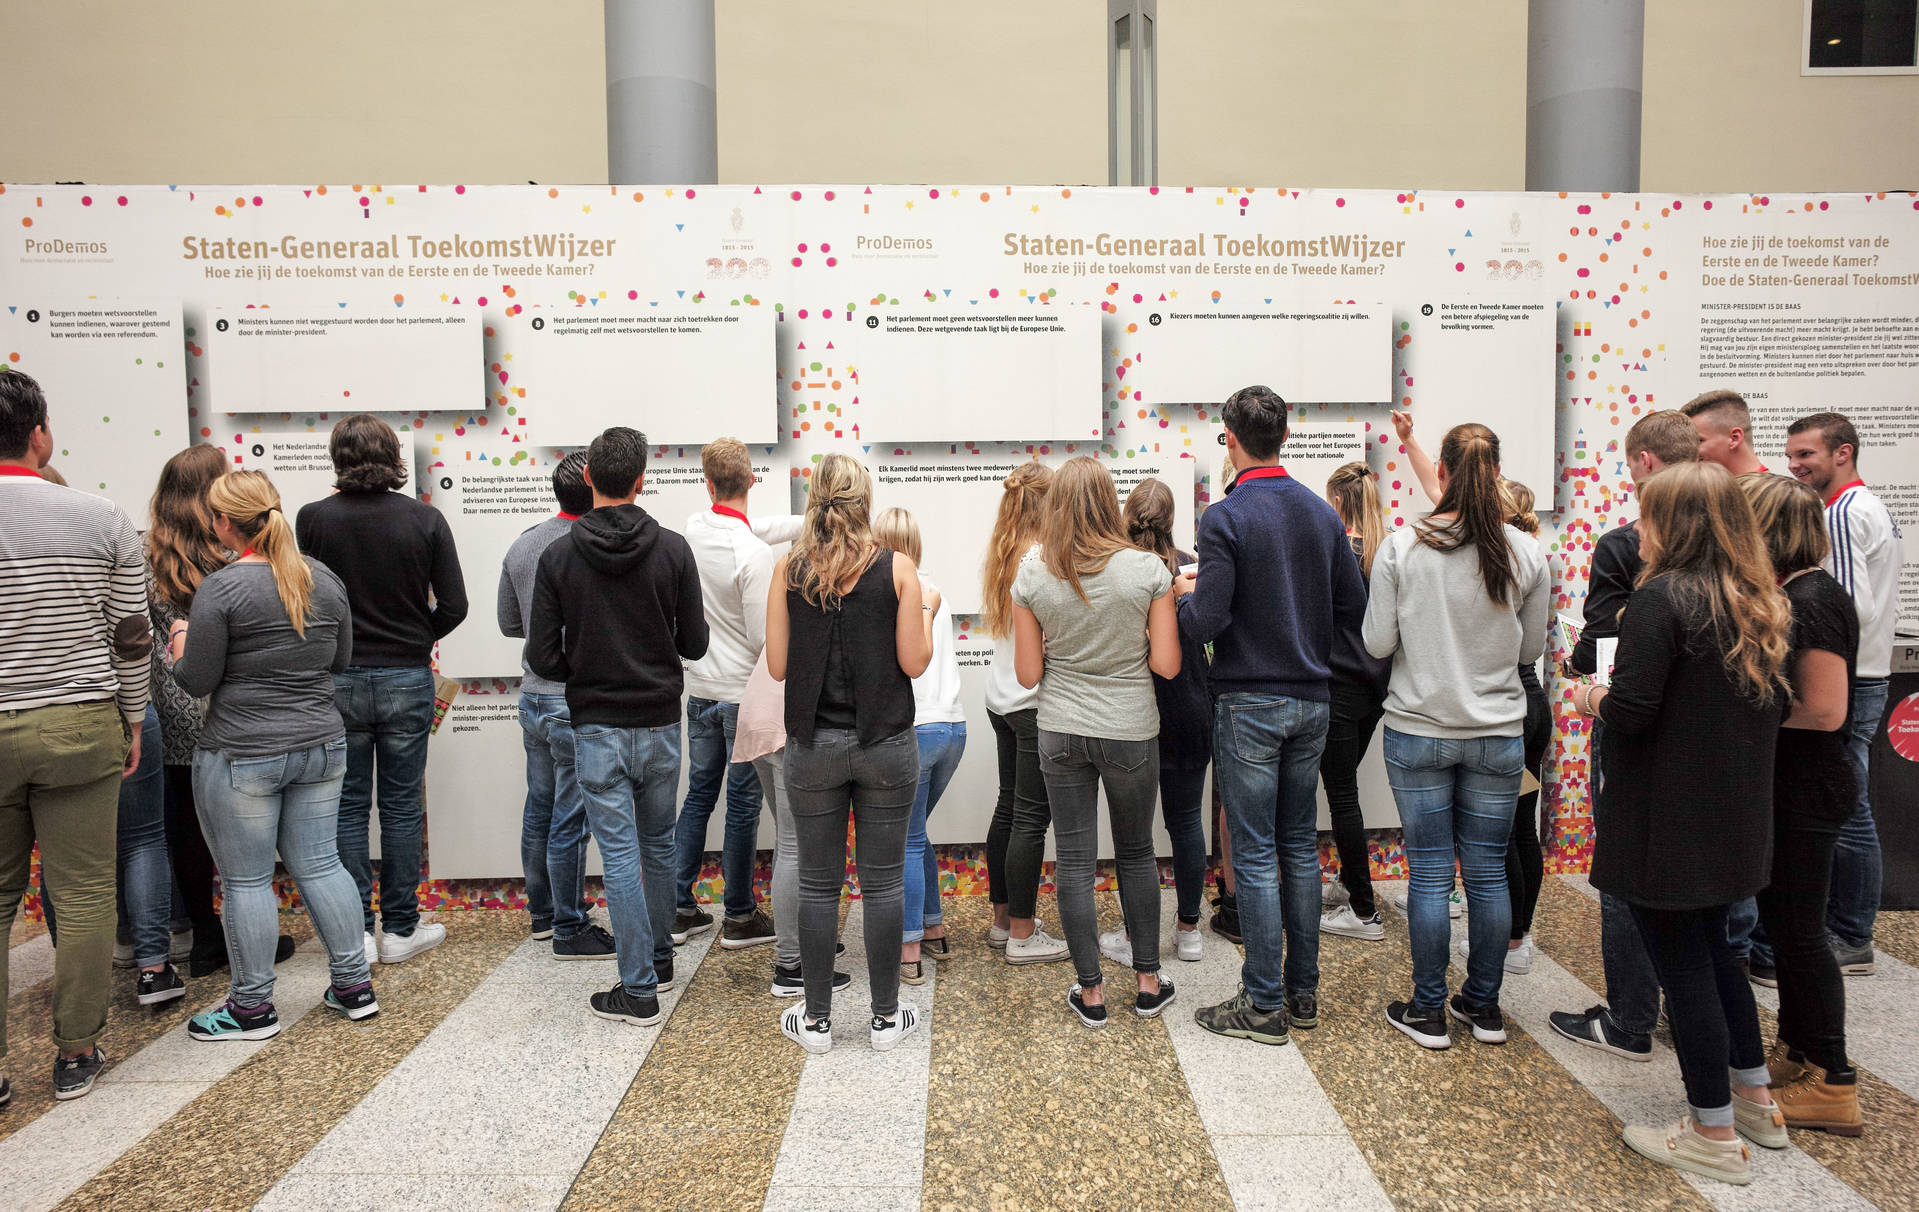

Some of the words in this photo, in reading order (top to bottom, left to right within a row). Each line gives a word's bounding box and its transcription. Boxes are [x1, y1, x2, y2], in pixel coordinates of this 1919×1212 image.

[25, 238, 107, 253] ProDemos
[856, 235, 932, 249] ProDemos
[1703, 236, 1726, 248] Hoe
[1730, 235, 1748, 248] zie
[1752, 235, 1764, 251] jij
[1768, 235, 1783, 248] de
[1786, 235, 1844, 248] toekomst
[1848, 238, 1870, 248] van
[1874, 235, 1889, 247] de
[183, 234, 399, 259] Staten-Generaal
[407, 233, 616, 262] ToekomstWijzer
[1003, 233, 1205, 256] Staten-Generaal
[1213, 233, 1405, 264] ToekomstWijzer
[1702, 255, 1740, 267] Eerste
[1744, 258, 1759, 267] en
[1762, 254, 1778, 267] de
[1781, 254, 1828, 267] Tweede
[1832, 254, 1878, 266] Kamer?
[204, 266, 230, 278] Hoe
[234, 265, 253, 278] zie
[257, 265, 270, 280] jij
[275, 265, 291, 278] de
[295, 265, 356, 277] toekomst
[360, 268, 384, 277] van
[388, 264, 404, 277] de
[408, 265, 449, 277] Eerste
[453, 267, 468, 276] en
[472, 264, 488, 276] de
[492, 263, 542, 276] Tweede
[546, 264, 594, 275] Kamer?
[1024, 262, 1048, 273] Hoe
[1051, 261, 1069, 273] zie
[1073, 261, 1085, 276] jij
[1089, 261, 1104, 274] de
[1108, 262, 1166, 274] toekomst
[1169, 265, 1191, 274] van
[1194, 262, 1210, 274] de
[1213, 262, 1251, 274] Eerste
[1254, 265, 1269, 274] en
[1272, 262, 1288, 274] de
[1291, 263, 1336, 275] Tweede
[1340, 263, 1384, 275] Kamer?
[1702, 274, 1726, 286] Doe
[1729, 273, 1744, 286] de
[1748, 273, 1848, 286] Staten-Generaal
[49, 310, 76, 318] Burgers
[1290, 312, 1340, 320] regeringscoalitie
[1473, 313, 1509, 321] afspiegeling
[310, 318, 352, 326] weggestuurd
[408, 316, 444, 325] parlement,
[566, 316, 598, 324] parlement
[898, 315, 930, 323] parlement
[76, 320, 108, 328] indienen,
[142, 320, 170, 328] gestemd
[1440, 323, 1470, 331] bevolking
[553, 327, 588, 335] regelmatig
[934, 325, 972, 333] wetgevende
[988, 325, 999, 333] ligt
[1000, 325, 1009, 333] bij
[1019, 325, 1048, 333] Europese
[308, 463, 333, 471] Brussel
[472, 475, 514, 484] belangrijkste
[452, 714, 510, 722] minister-president
[452, 724, 480, 733] gekozen.
